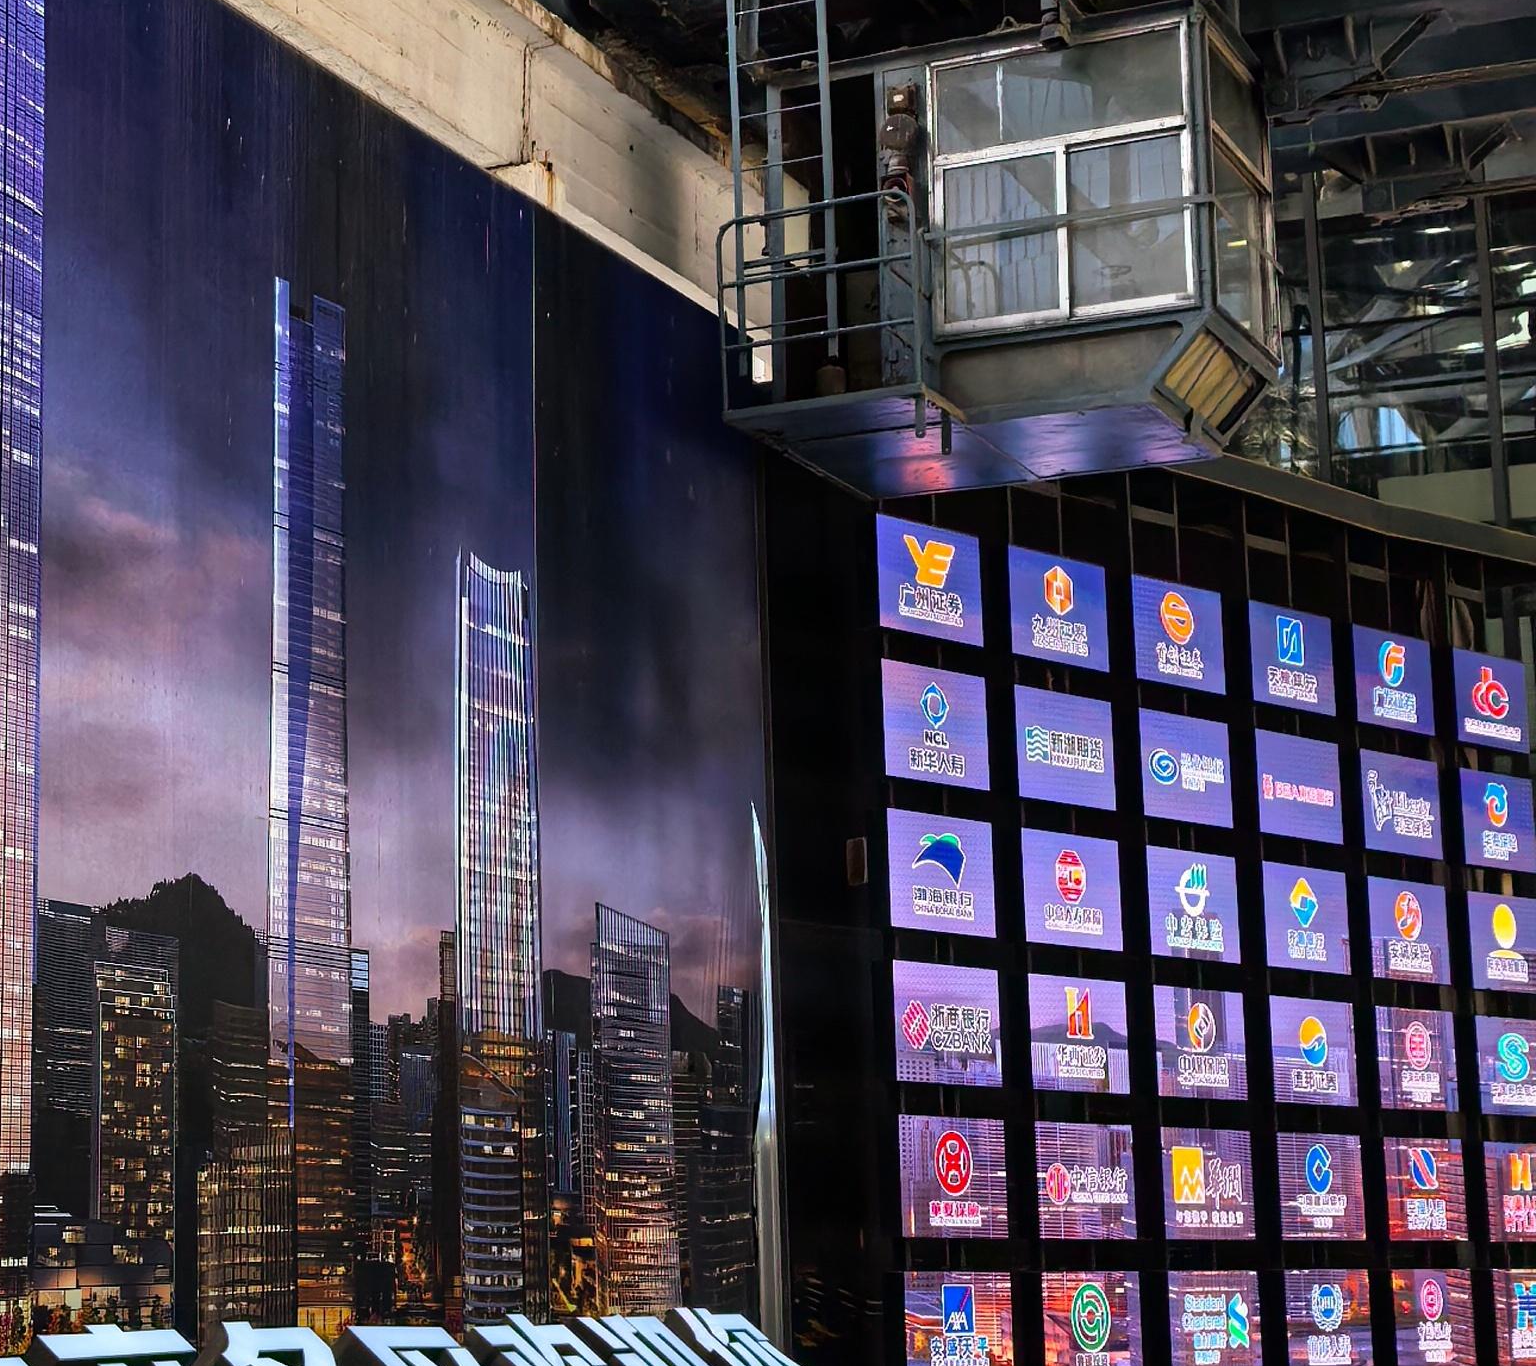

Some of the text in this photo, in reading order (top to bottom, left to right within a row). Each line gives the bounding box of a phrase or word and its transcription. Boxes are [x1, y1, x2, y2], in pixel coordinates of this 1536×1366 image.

[900, 583, 962, 616] 广州证券
[1032, 615, 1087, 642] 九州证券
[924, 730, 949, 749] NCL
[1050, 731, 1104, 761] 新湖期货
[909, 747, 965, 777] 新华人寿
[913, 886, 974, 908] 渤海银行
[931, 1003, 991, 1033] 浙商银行
[931, 1030, 992, 1054] CZBANK
[1071, 1165, 1127, 1193] 中信银行
[1184, 1294, 1226, 1311] Standard
[948, 1311, 968, 1330] AXA
[931, 1336, 989, 1358] 安盛天平
